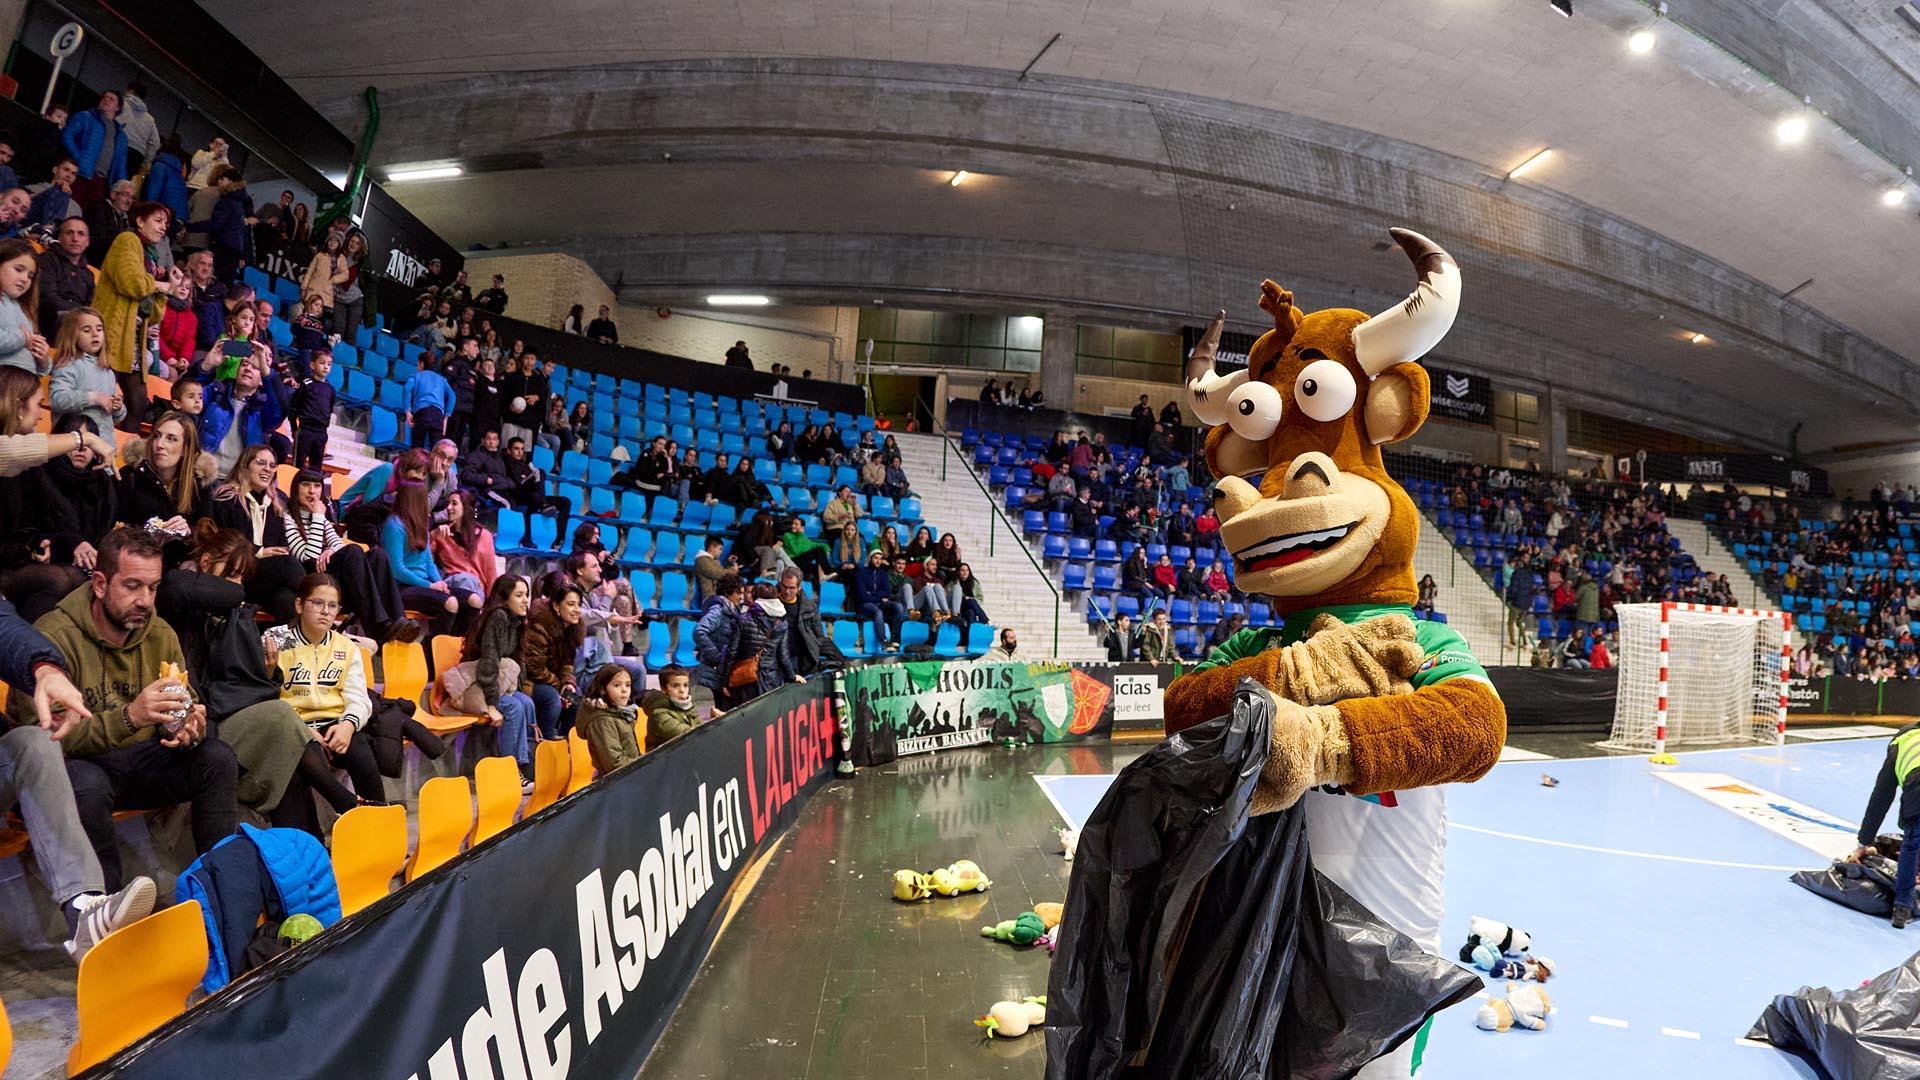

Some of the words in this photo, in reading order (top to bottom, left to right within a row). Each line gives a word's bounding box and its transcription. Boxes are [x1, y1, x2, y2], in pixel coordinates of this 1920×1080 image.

[59, 30, 75, 50] G
[936, 667, 1014, 693] HOOLS
[1115, 677, 1152, 695] icias
[1134, 702, 1151, 711] lees
[576, 783, 714, 1046] Asobal
[712, 777, 747, 872] en
[745, 697, 837, 845] LALIGA+
